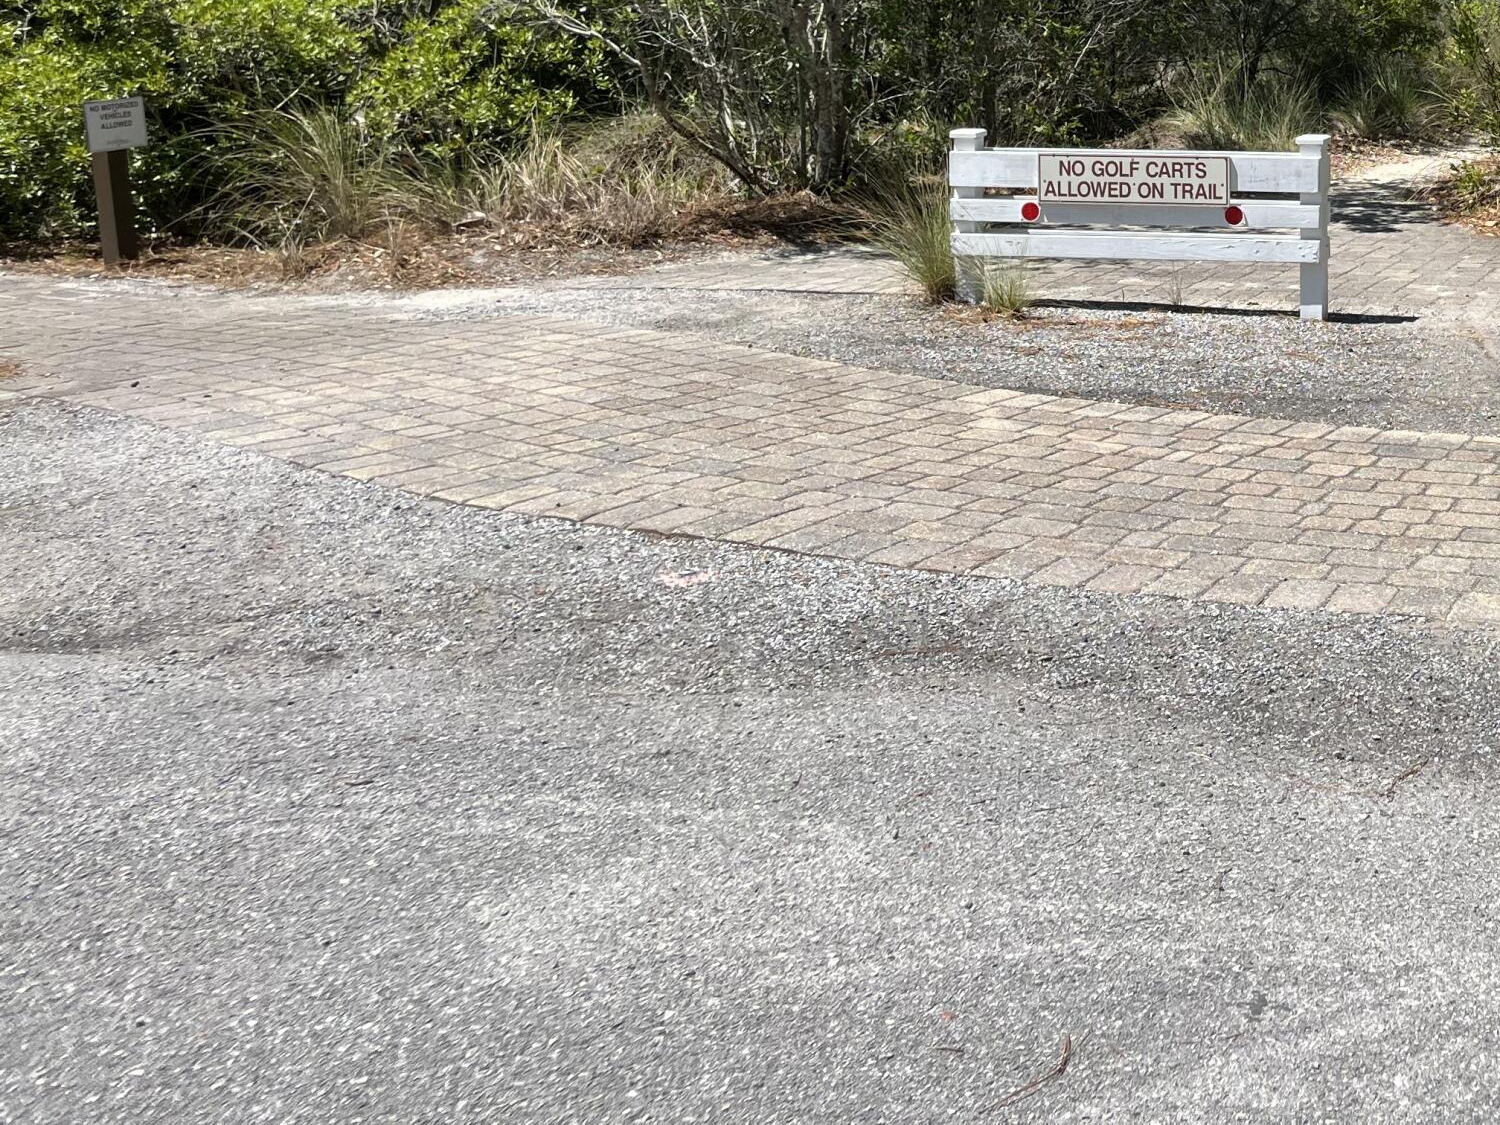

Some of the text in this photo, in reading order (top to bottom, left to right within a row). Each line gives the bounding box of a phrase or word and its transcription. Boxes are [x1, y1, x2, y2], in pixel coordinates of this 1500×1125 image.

[101, 101, 139, 111] MOTORIZED
[100, 111, 131, 120] VEHICLES
[101, 120, 133, 129] ALLOWED
[1058, 160, 1207, 179] NO GOLF CARTS
[1043, 180, 1223, 200] ALLOWED ON TRAIL
